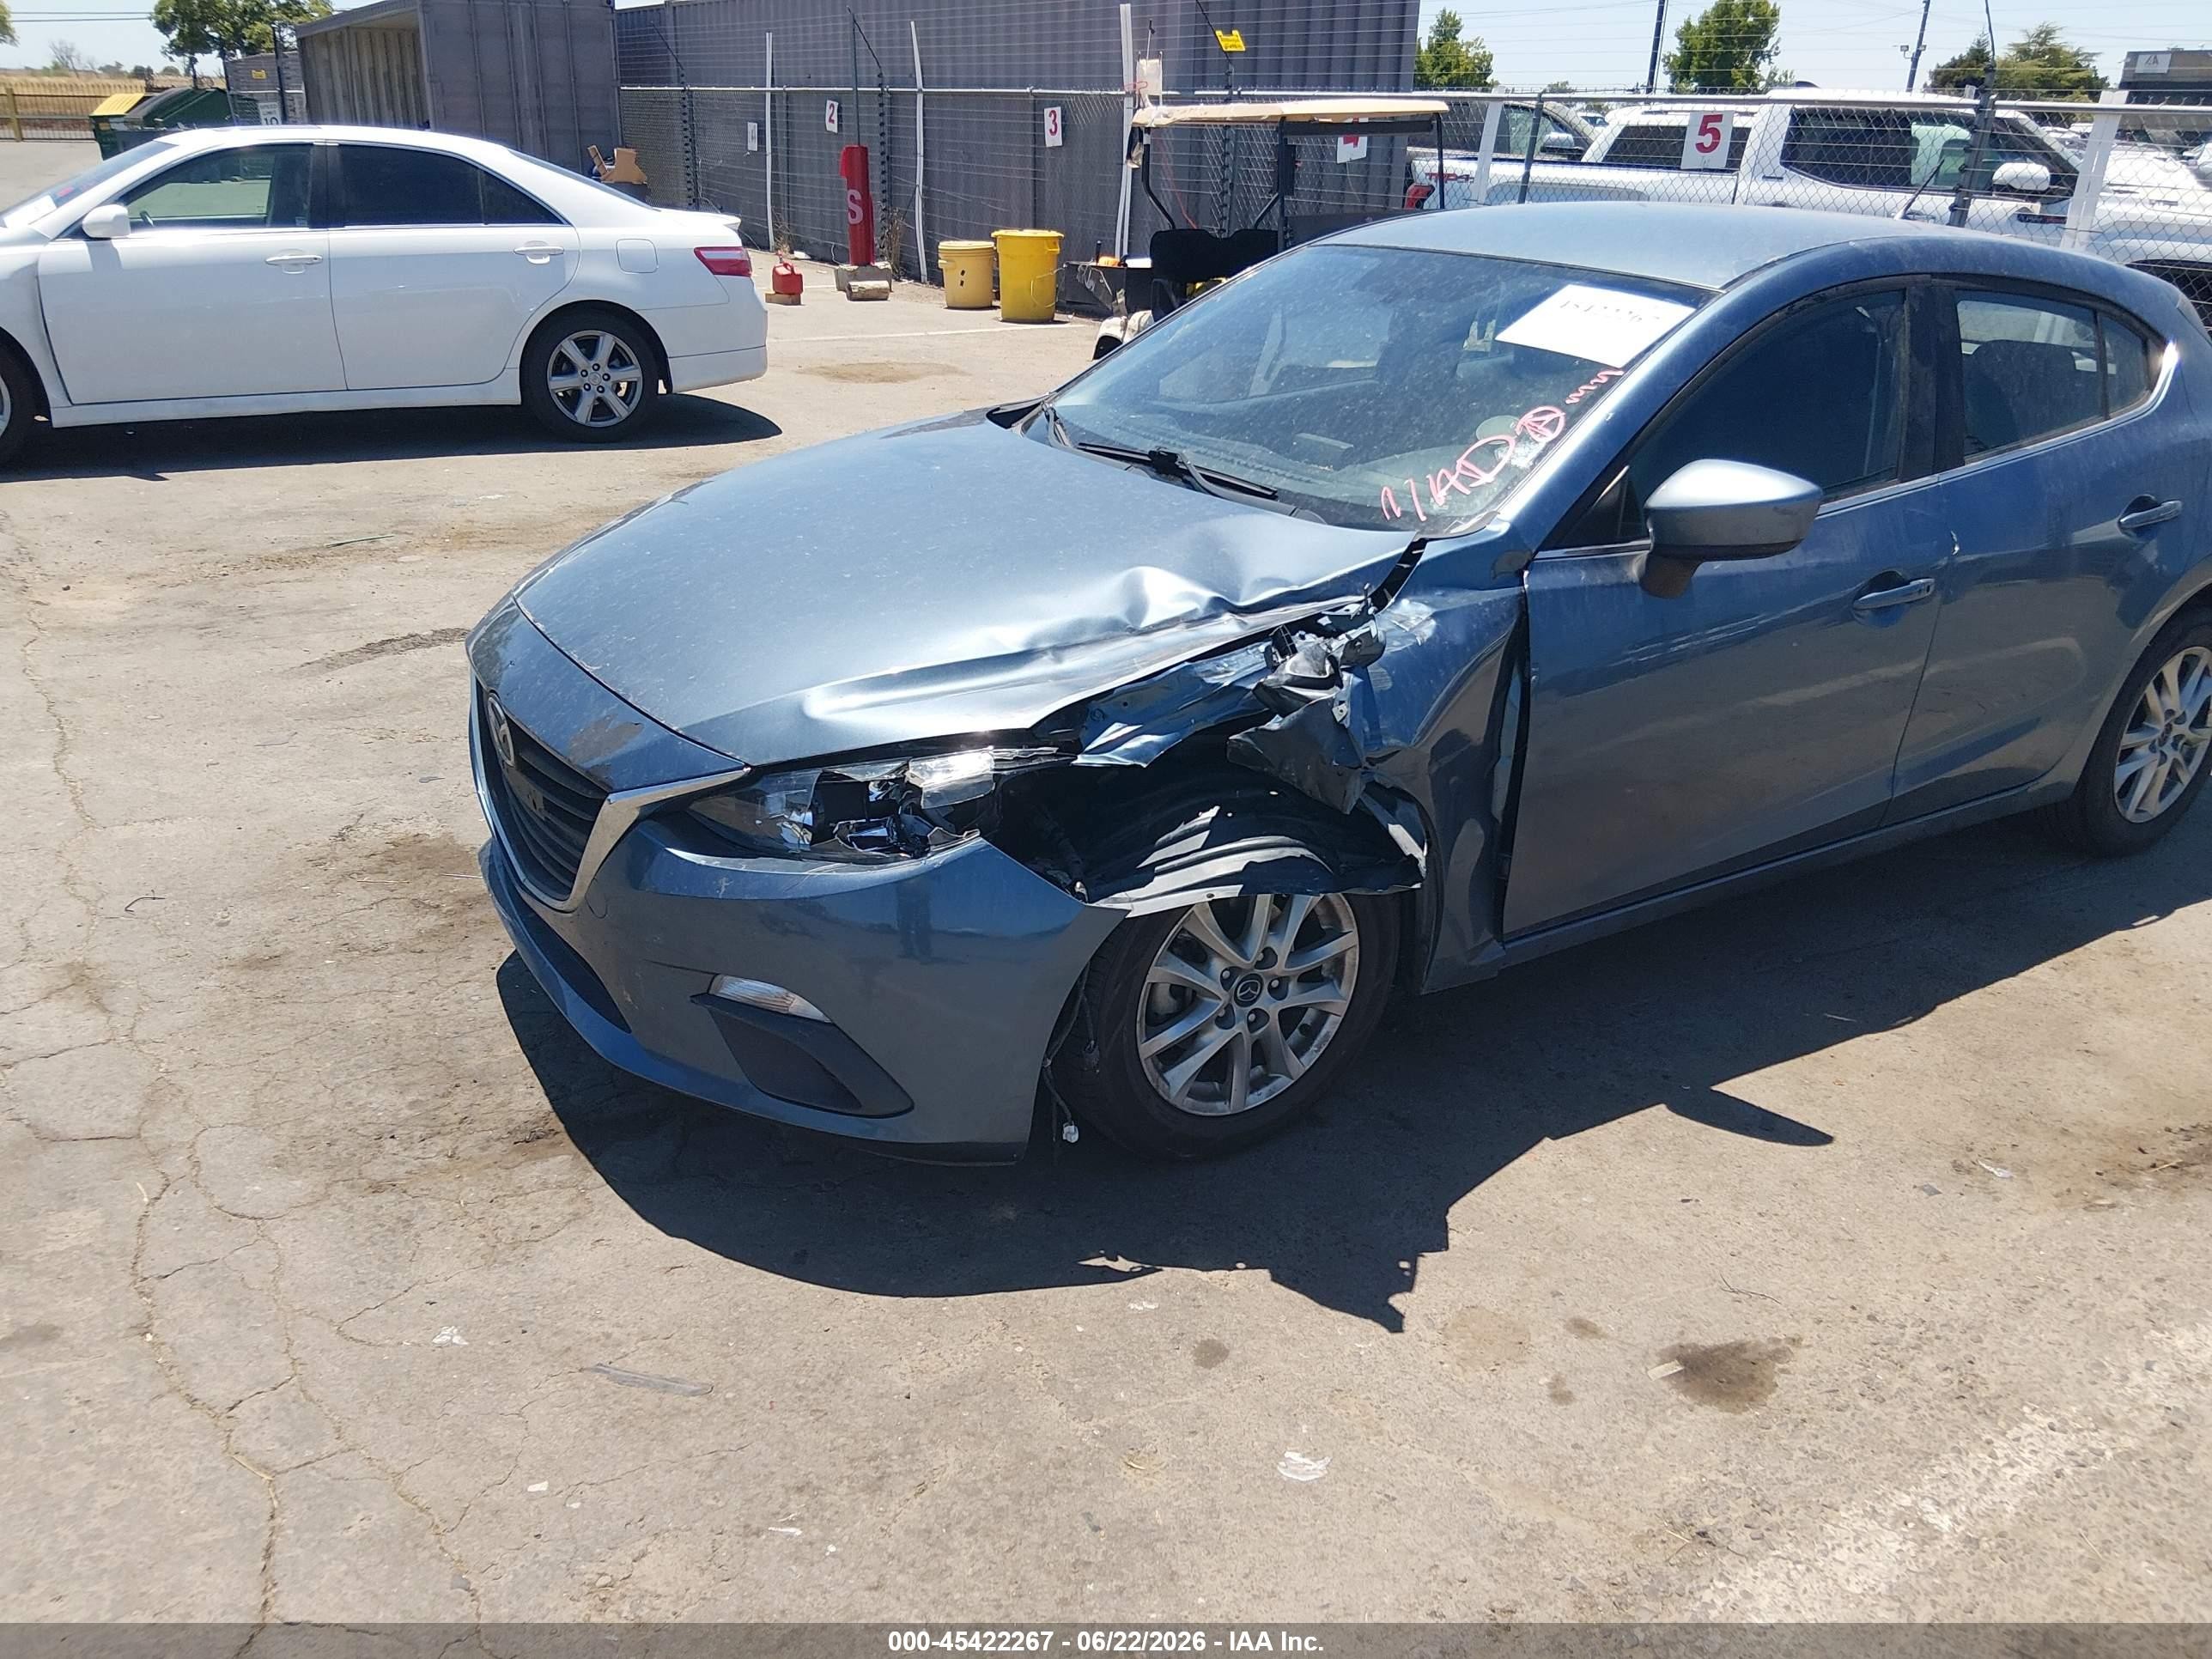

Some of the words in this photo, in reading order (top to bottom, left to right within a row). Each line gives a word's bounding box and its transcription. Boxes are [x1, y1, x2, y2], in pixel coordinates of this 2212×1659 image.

[828, 103, 836, 125] 2
[1048, 109, 1058, 137] 3
[1695, 113, 1723, 154] 5
[847, 189, 864, 225] S
